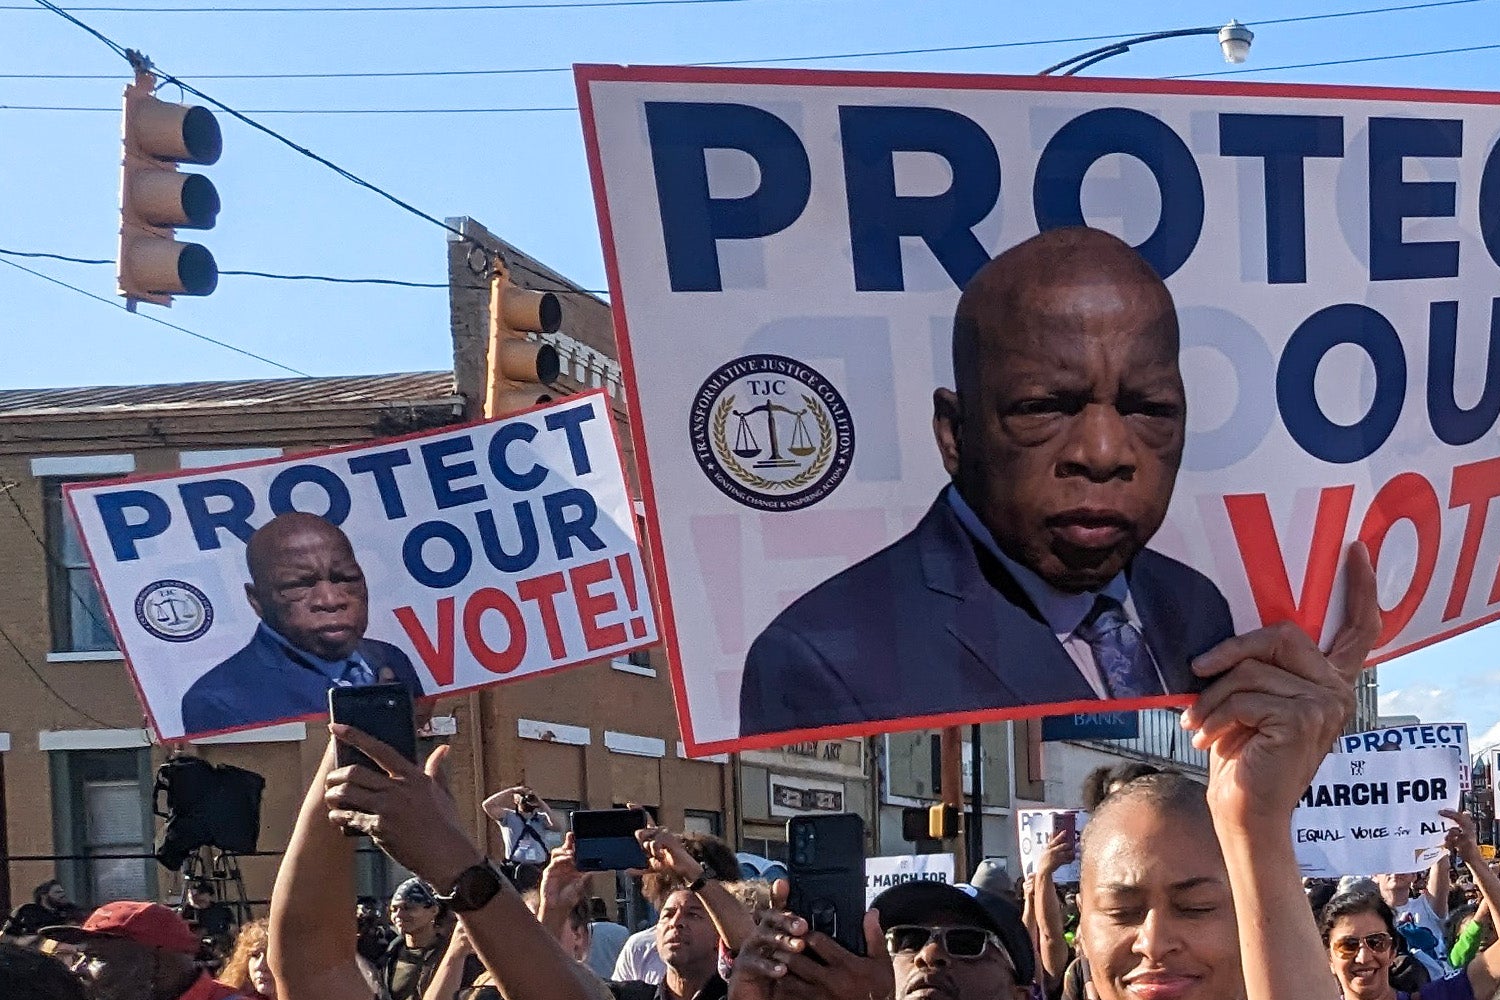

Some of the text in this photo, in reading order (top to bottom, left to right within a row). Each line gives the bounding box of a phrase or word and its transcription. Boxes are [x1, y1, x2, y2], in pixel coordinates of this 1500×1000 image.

[761, 359, 818, 386] JUSTICE
[747, 380, 786, 395] TJC
[693, 359, 758, 462] TRANSFORMATIVE
[818, 384, 849, 457] COALITION
[94, 403, 595, 561] PROTECT
[402, 488, 607, 588] OUR
[393, 554, 646, 686] VOTE!
[1074, 713, 1126, 726] BANK
[1345, 725, 1464, 753] PROTECT
[1297, 778, 1447, 807] MARCH FOR
[1297, 828, 1345, 843] EQUAL
[1351, 826, 1389, 840] VOICE
[1420, 821, 1450, 835] ALL
[873, 873, 918, 887] MARCH
